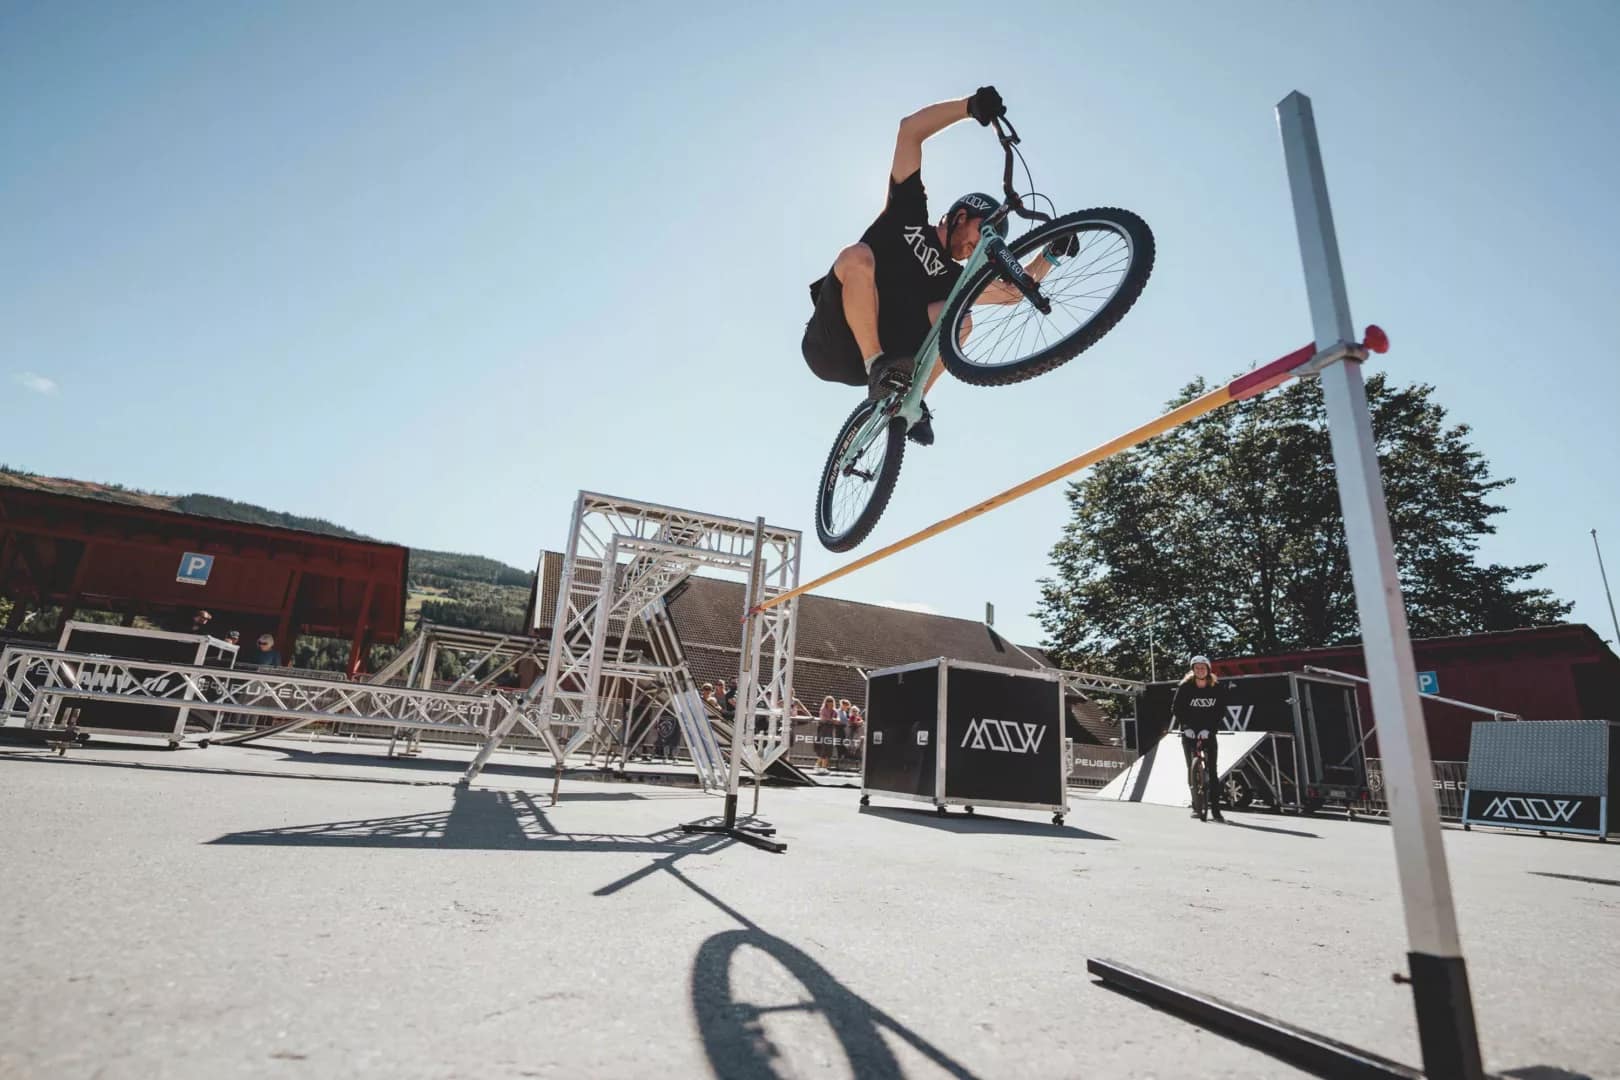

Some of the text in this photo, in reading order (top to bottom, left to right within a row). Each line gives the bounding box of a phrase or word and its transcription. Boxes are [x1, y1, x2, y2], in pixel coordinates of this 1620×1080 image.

[999, 249, 1025, 277] PEUGEOT
[187, 556, 206, 576] P
[1419, 674, 1433, 691] P
[795, 734, 861, 747] PEUGEOT
[1075, 758, 1125, 769] PEUGEOT
